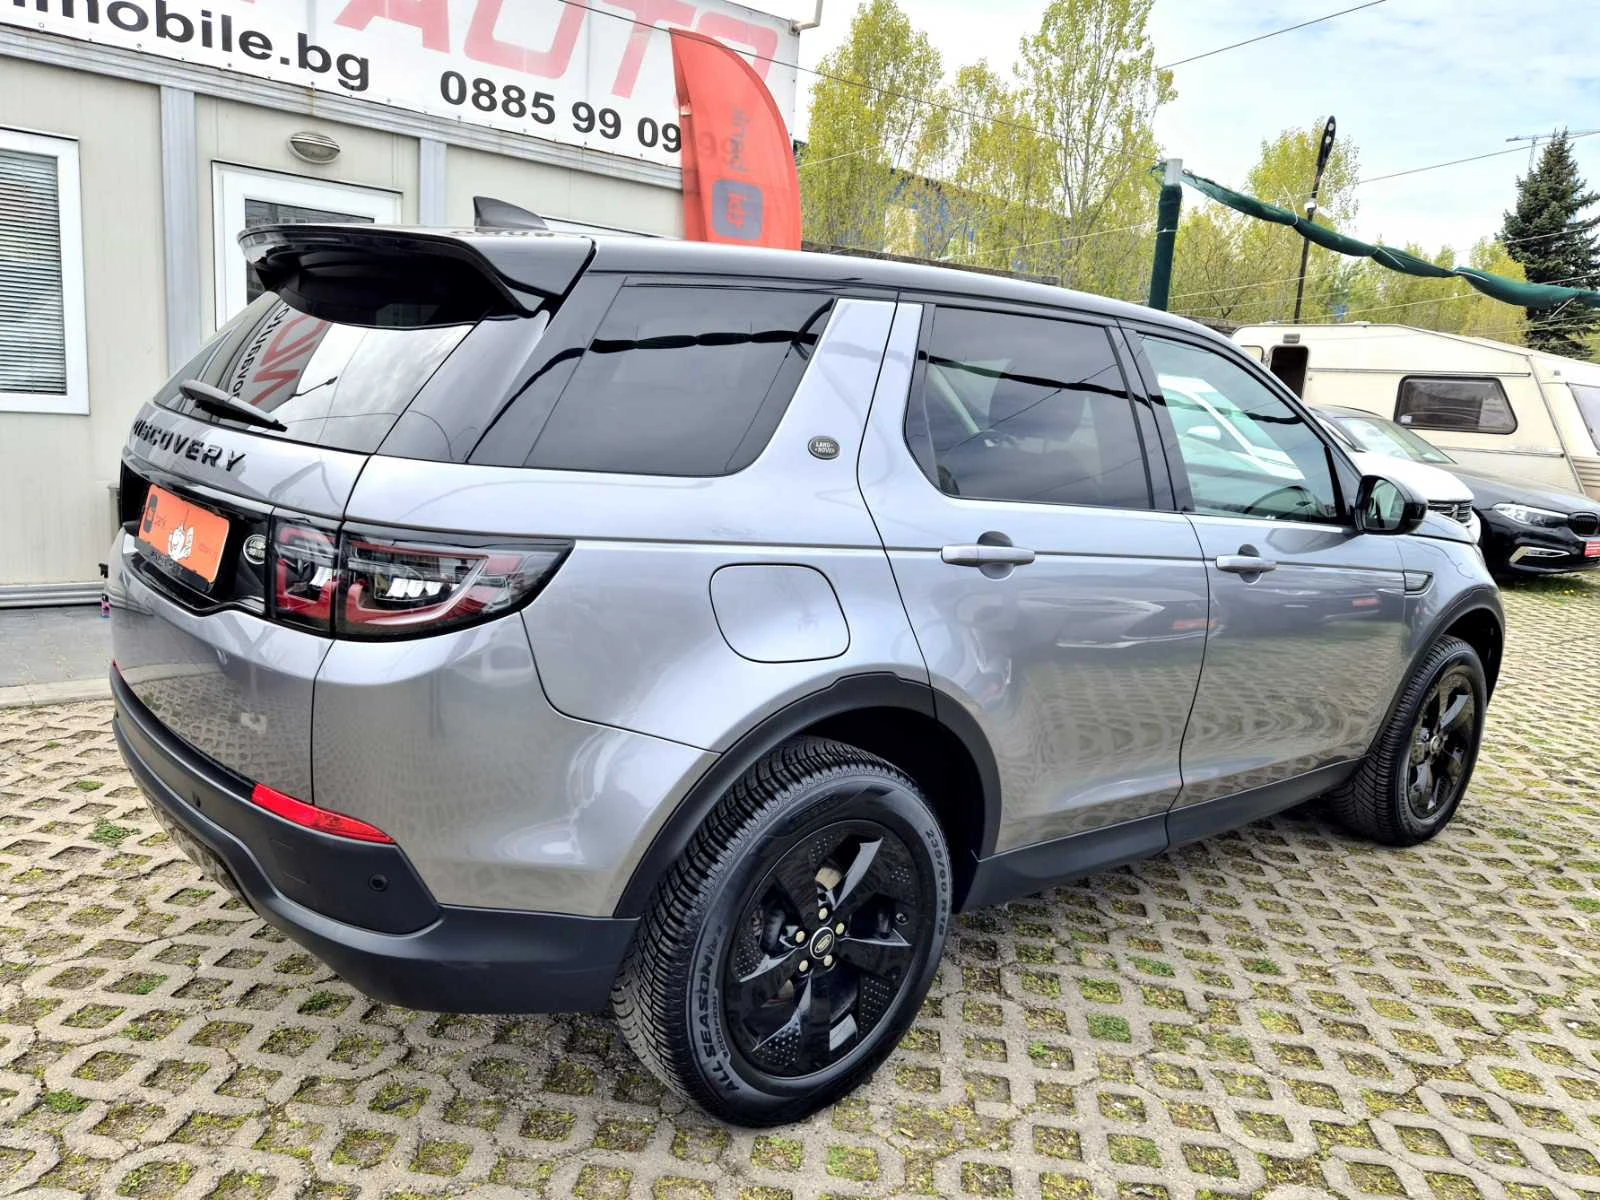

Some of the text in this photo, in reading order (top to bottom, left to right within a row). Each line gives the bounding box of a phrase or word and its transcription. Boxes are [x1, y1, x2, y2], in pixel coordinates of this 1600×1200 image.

[440, 70, 556, 125] 0885
[572, 101, 621, 139] 99
[637, 116, 682, 153] 09
[133, 419, 247, 472] DISCOVERY
[699, 954, 717, 1058] SEASON
[712, 1060, 740, 1091] ALL
